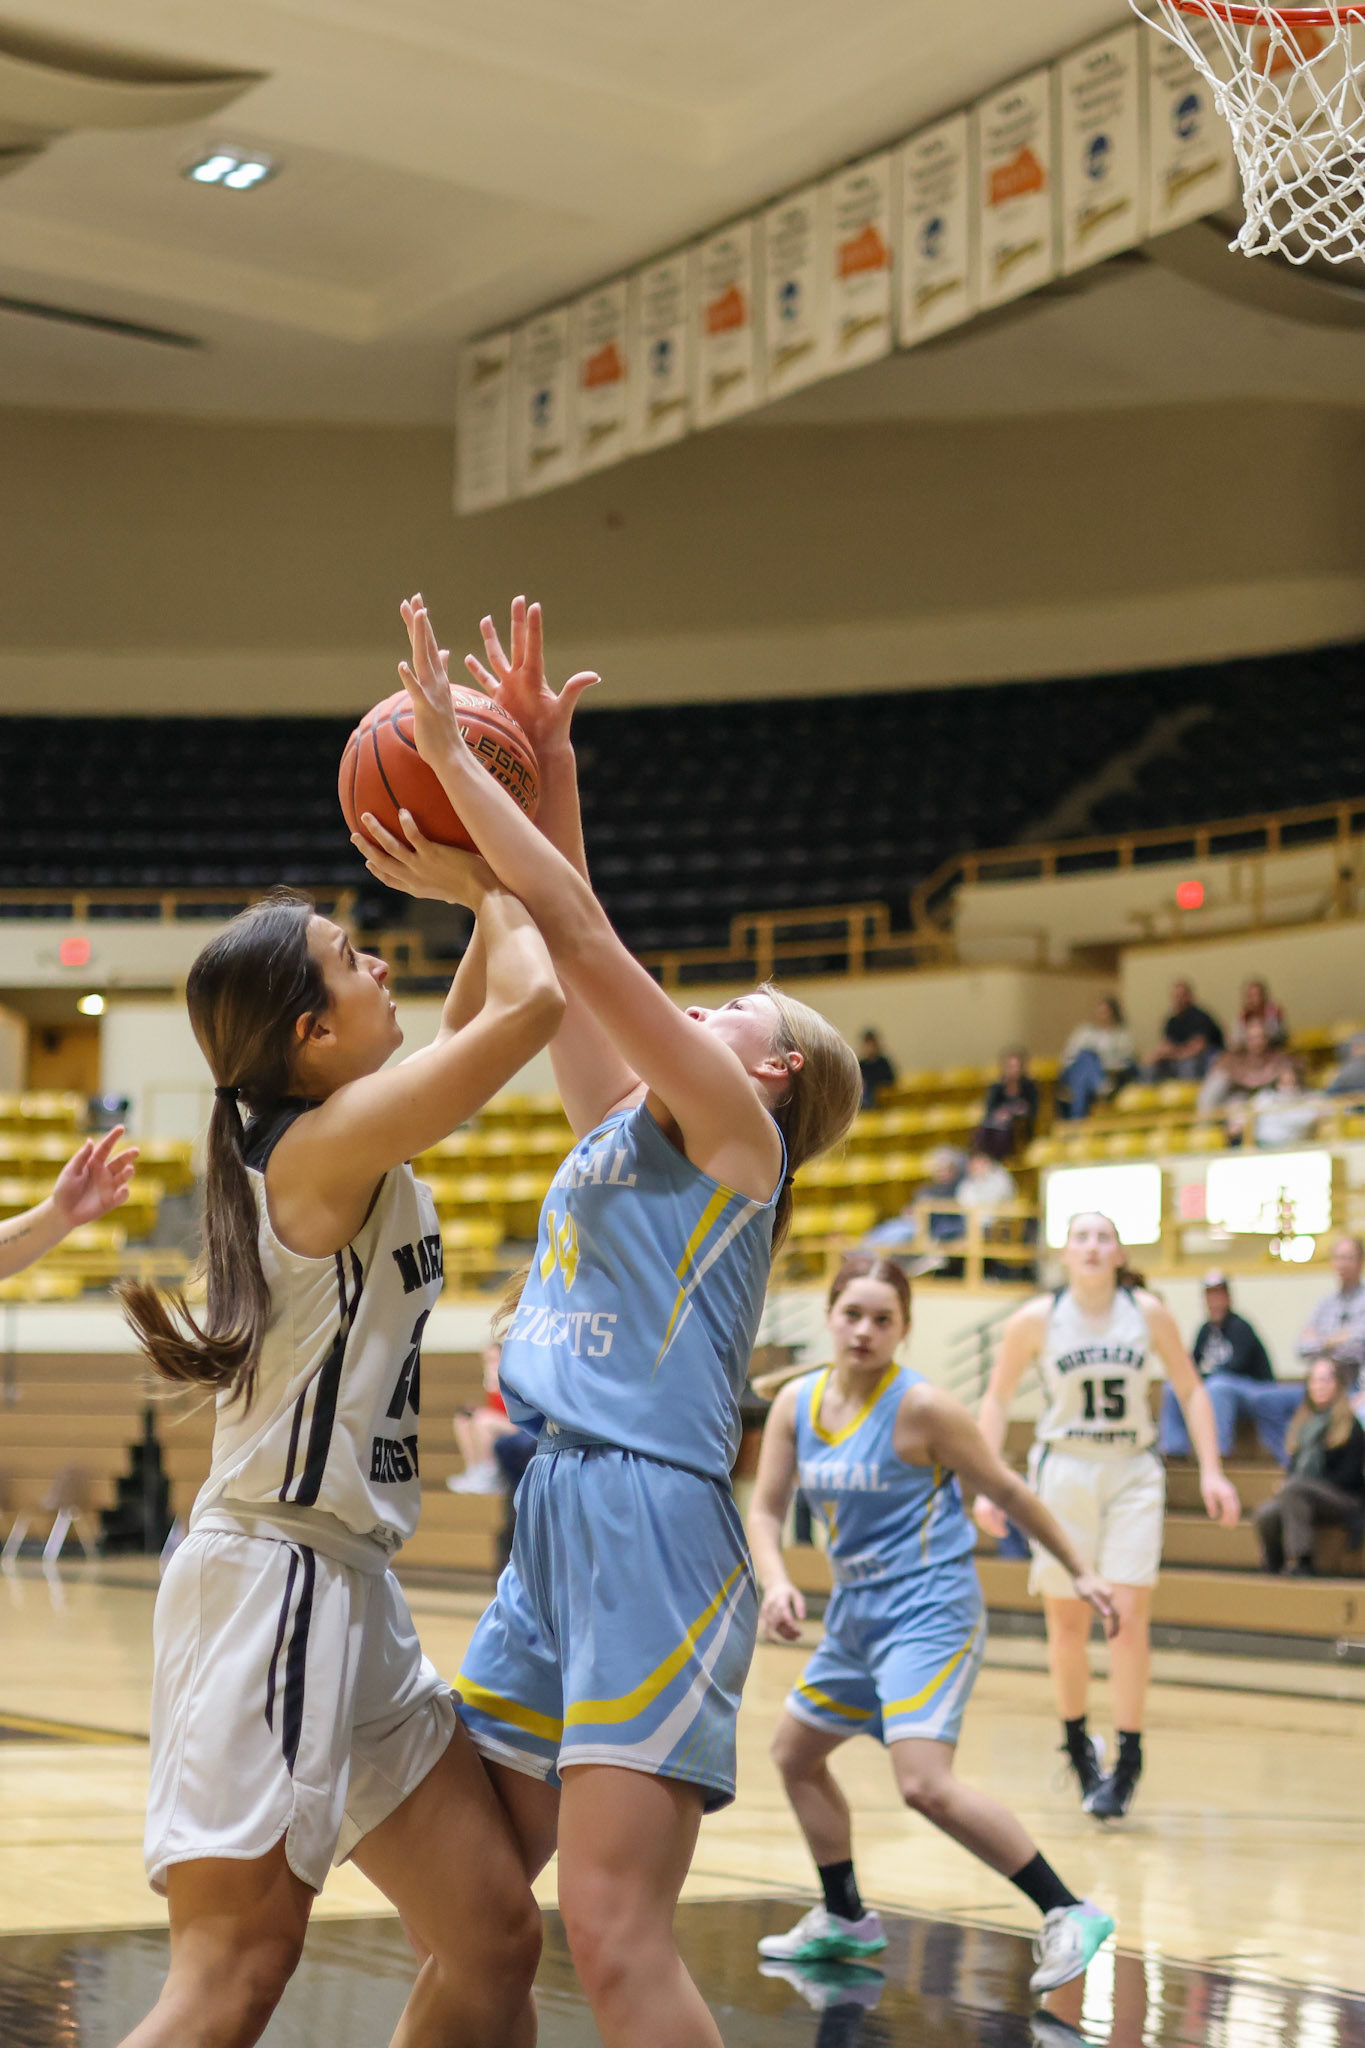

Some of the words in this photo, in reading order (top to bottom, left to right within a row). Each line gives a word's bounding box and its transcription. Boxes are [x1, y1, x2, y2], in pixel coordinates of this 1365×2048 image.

[461, 725, 538, 800] LEGACY
[392, 1234, 443, 1294] NOR
[1083, 1378, 1125, 1419] 15
